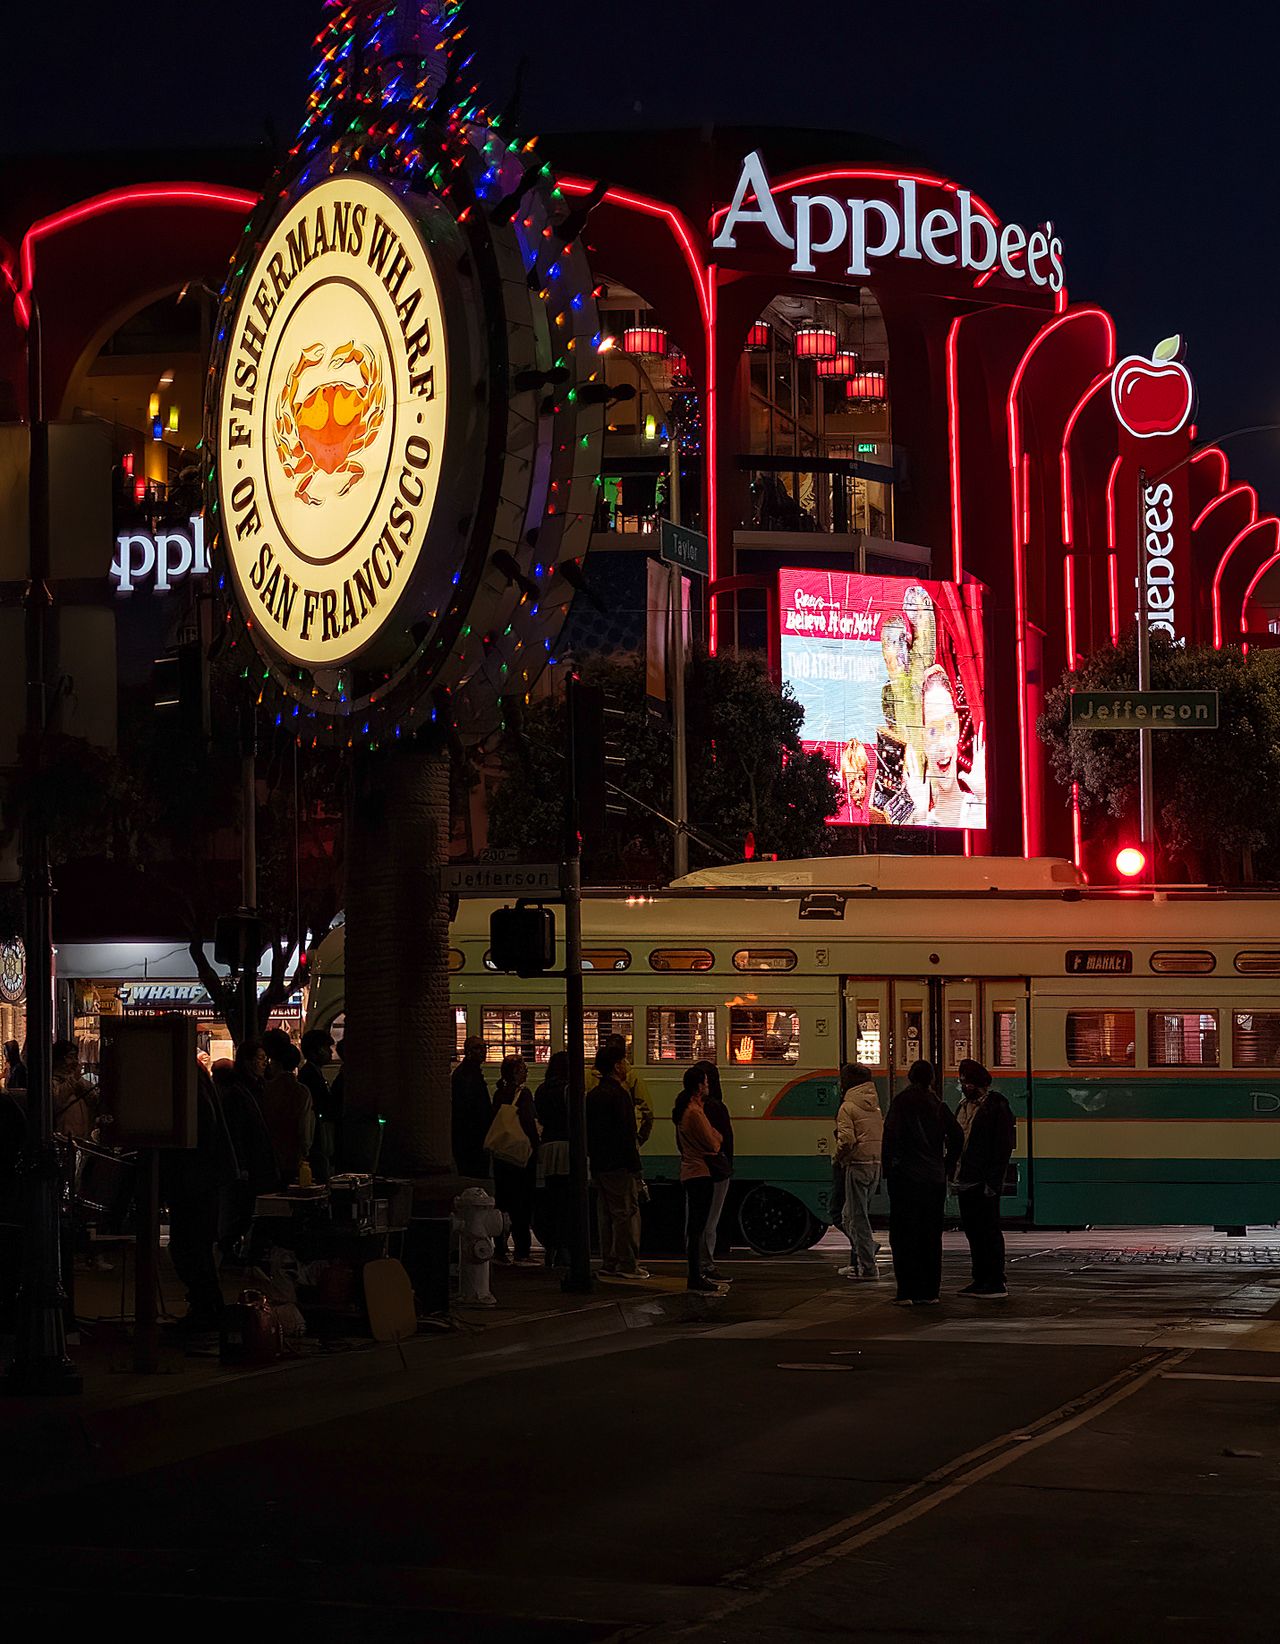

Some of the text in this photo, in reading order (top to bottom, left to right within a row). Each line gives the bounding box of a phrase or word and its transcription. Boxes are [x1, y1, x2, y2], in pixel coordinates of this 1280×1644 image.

[713, 151, 1064, 292] Applebee's
[228, 201, 436, 450] FISHERMANS WHARF
[110, 516, 212, 591] ppl
[231, 435, 431, 642] OF SAN FRANCISCO
[672, 533, 699, 561] Taylor
[1079, 699, 1209, 720] Jefferson
[451, 871, 549, 887] Jefferson
